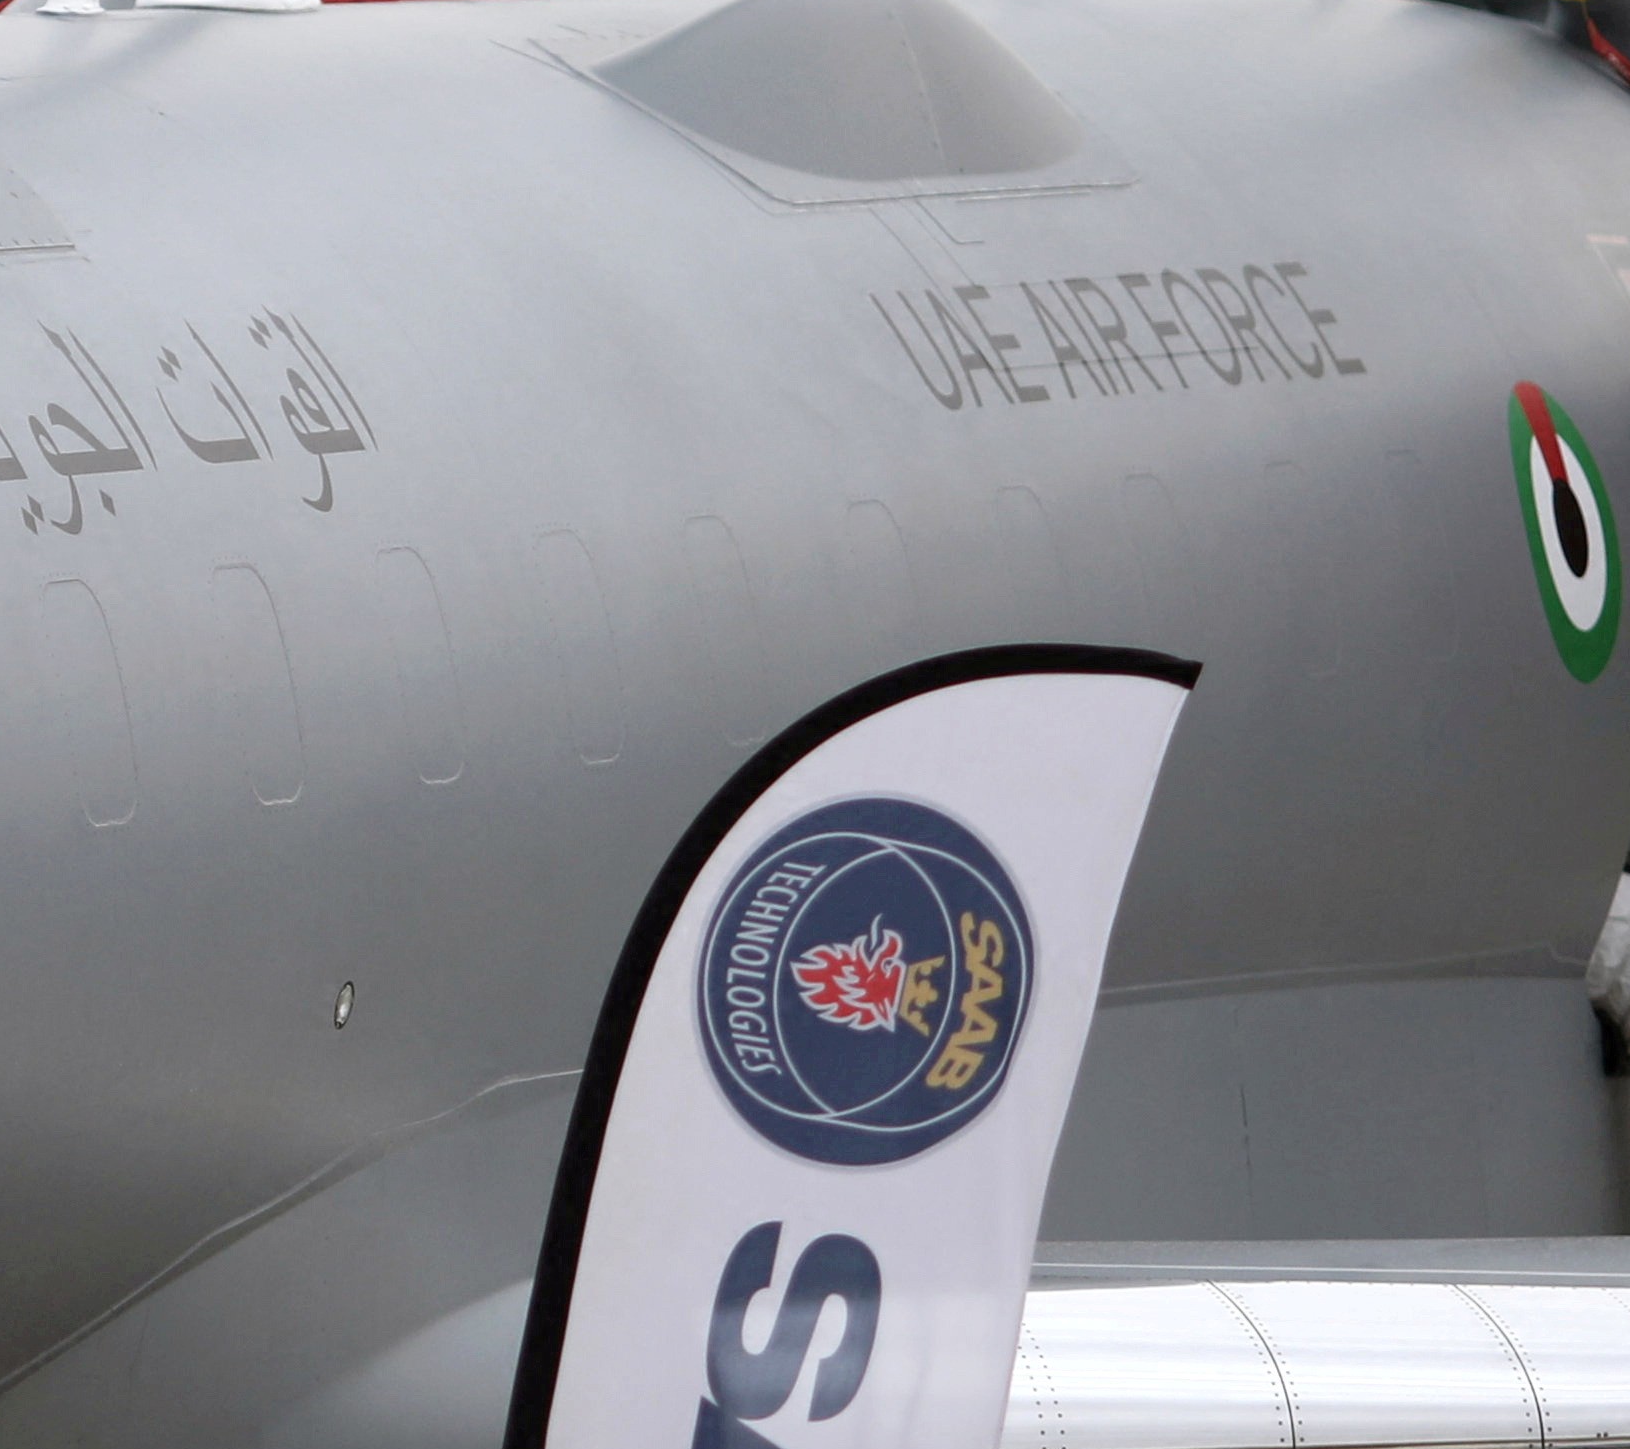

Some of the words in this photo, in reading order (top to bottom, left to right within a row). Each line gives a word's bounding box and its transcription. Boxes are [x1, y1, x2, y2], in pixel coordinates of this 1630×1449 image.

[870, 285, 1049, 411] UAE
[1018, 276, 1164, 400] AIR
[1119, 261, 1368, 390] FORCE
[725, 860, 828, 1077] TECHNOLOGIES
[925, 910, 1005, 1092] SAAB
